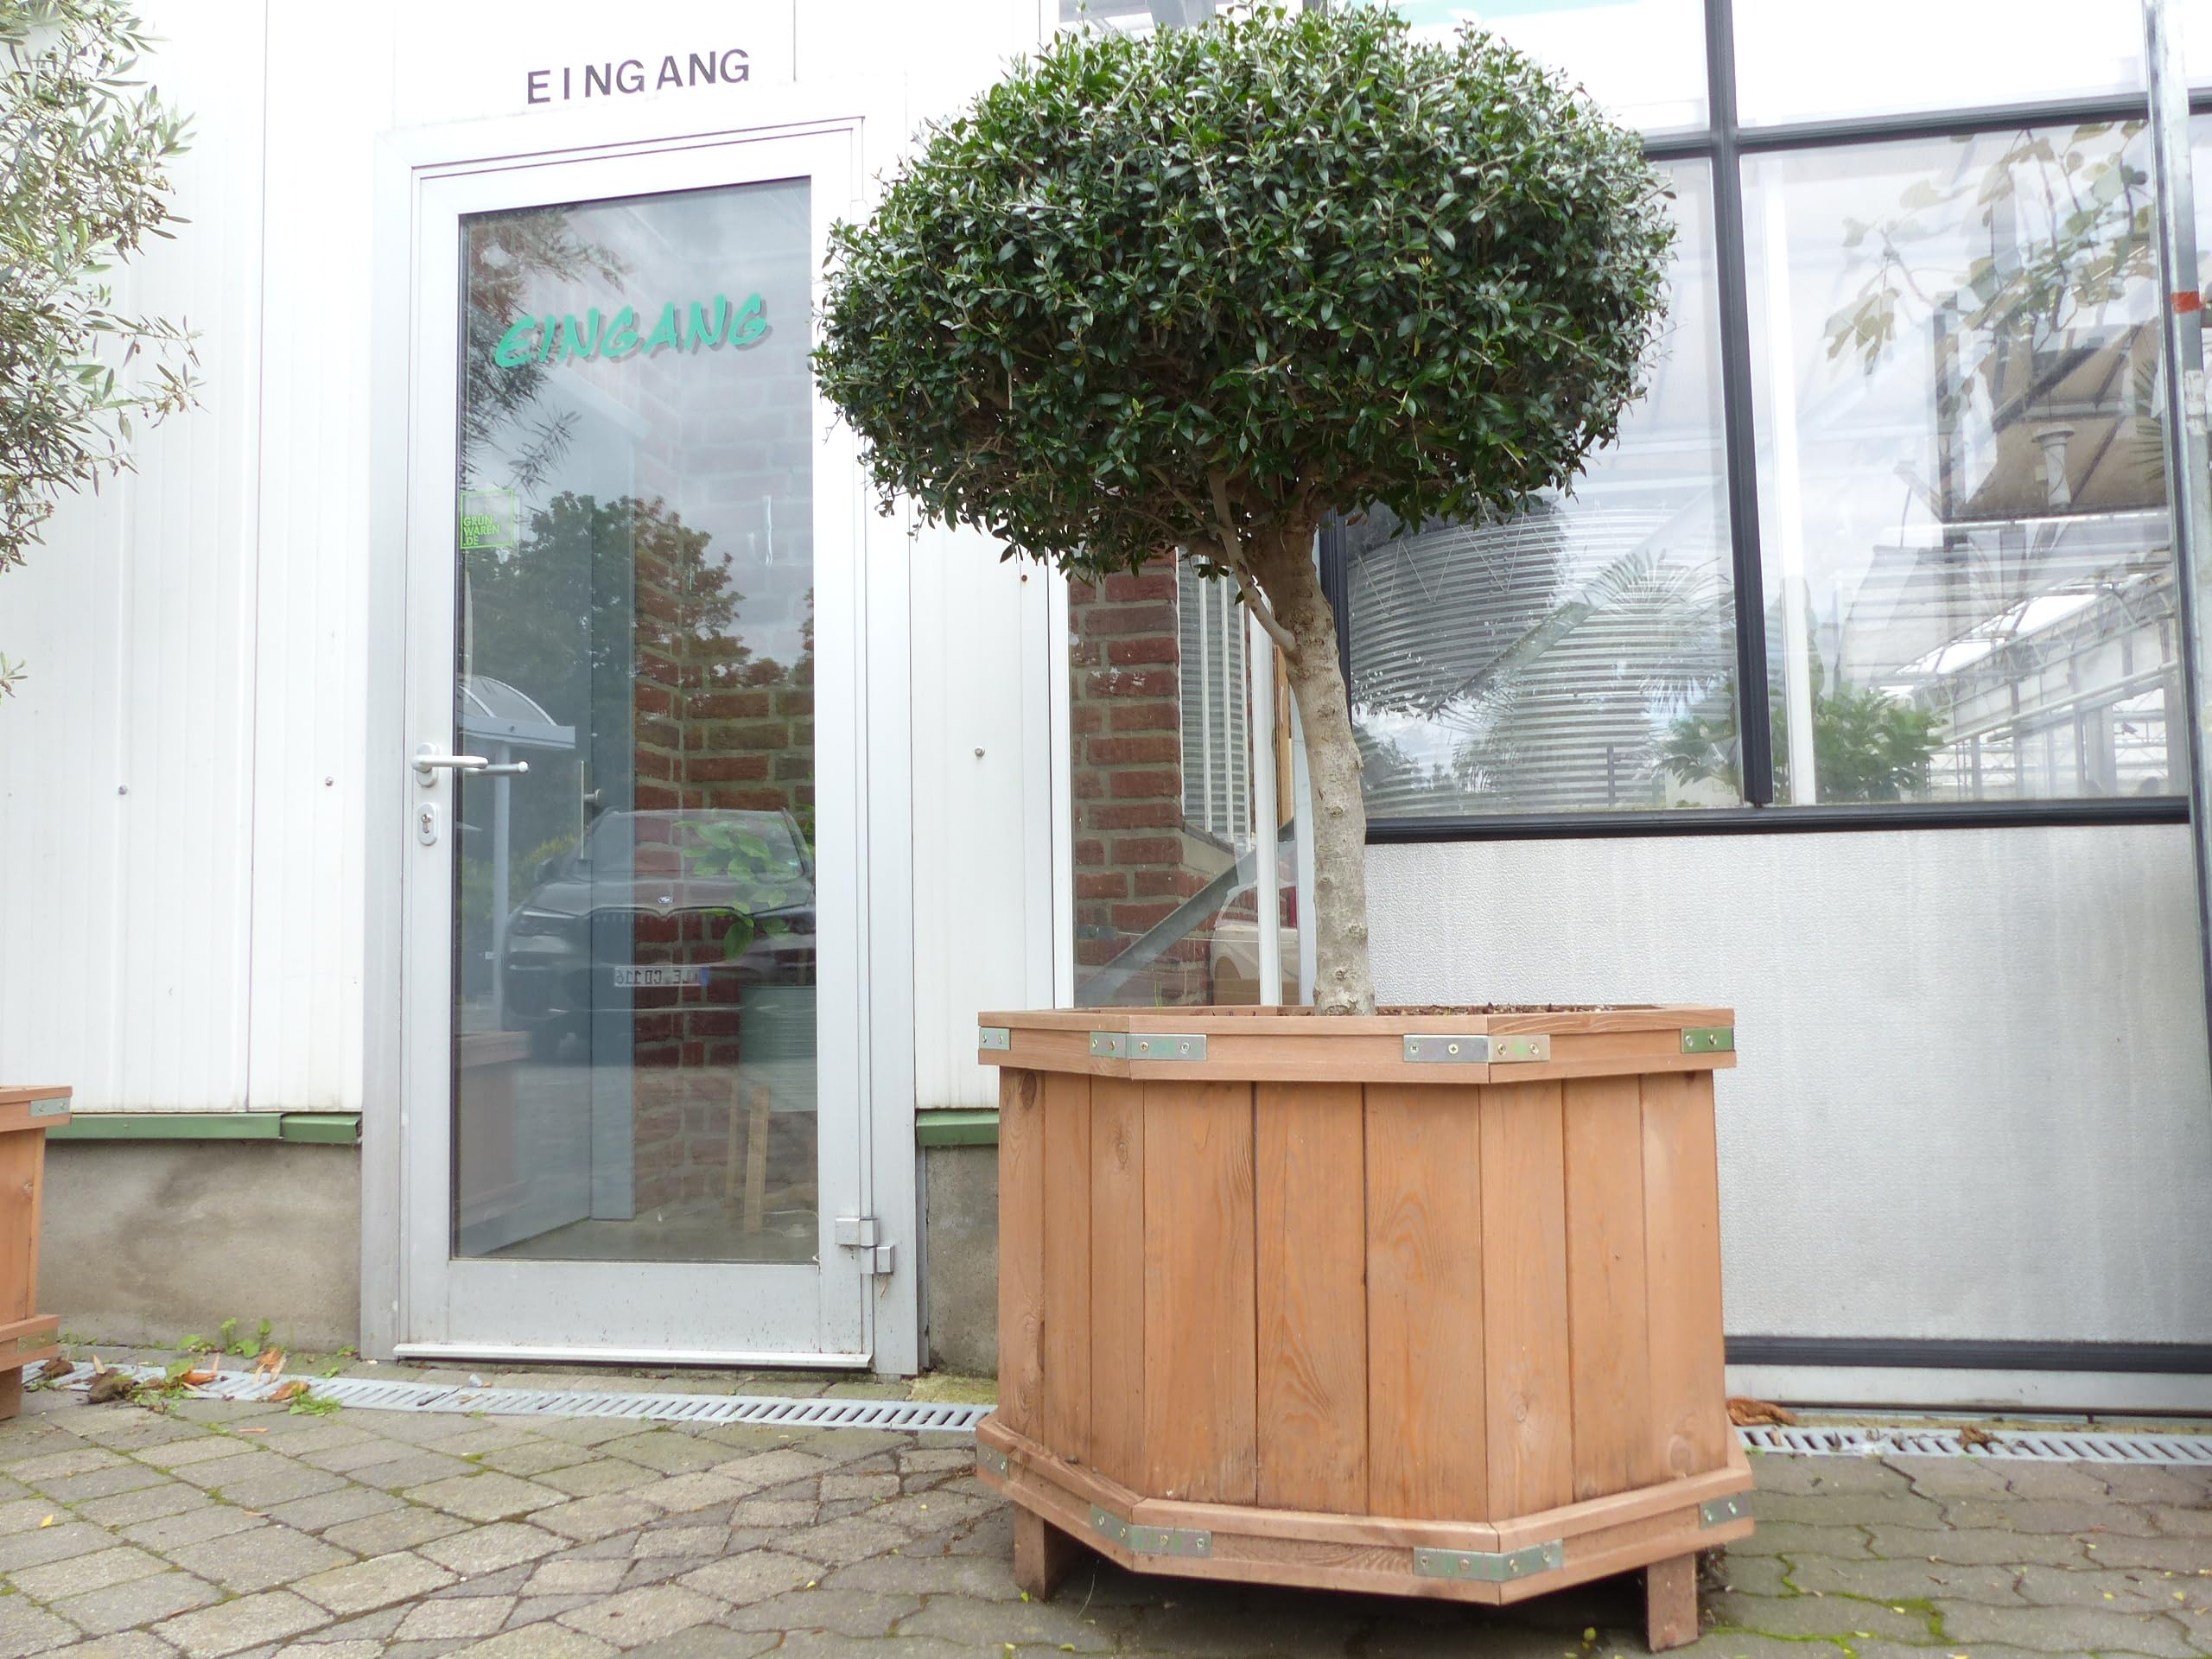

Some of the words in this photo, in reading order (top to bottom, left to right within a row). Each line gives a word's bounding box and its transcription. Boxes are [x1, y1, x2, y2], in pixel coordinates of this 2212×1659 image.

[528, 48, 750, 105] EINGANG
[494, 292, 769, 368] EINGANG
[464, 514, 492, 526] GRÜN
[464, 525, 499, 536] WAREN
[464, 537, 479, 546] .DE
